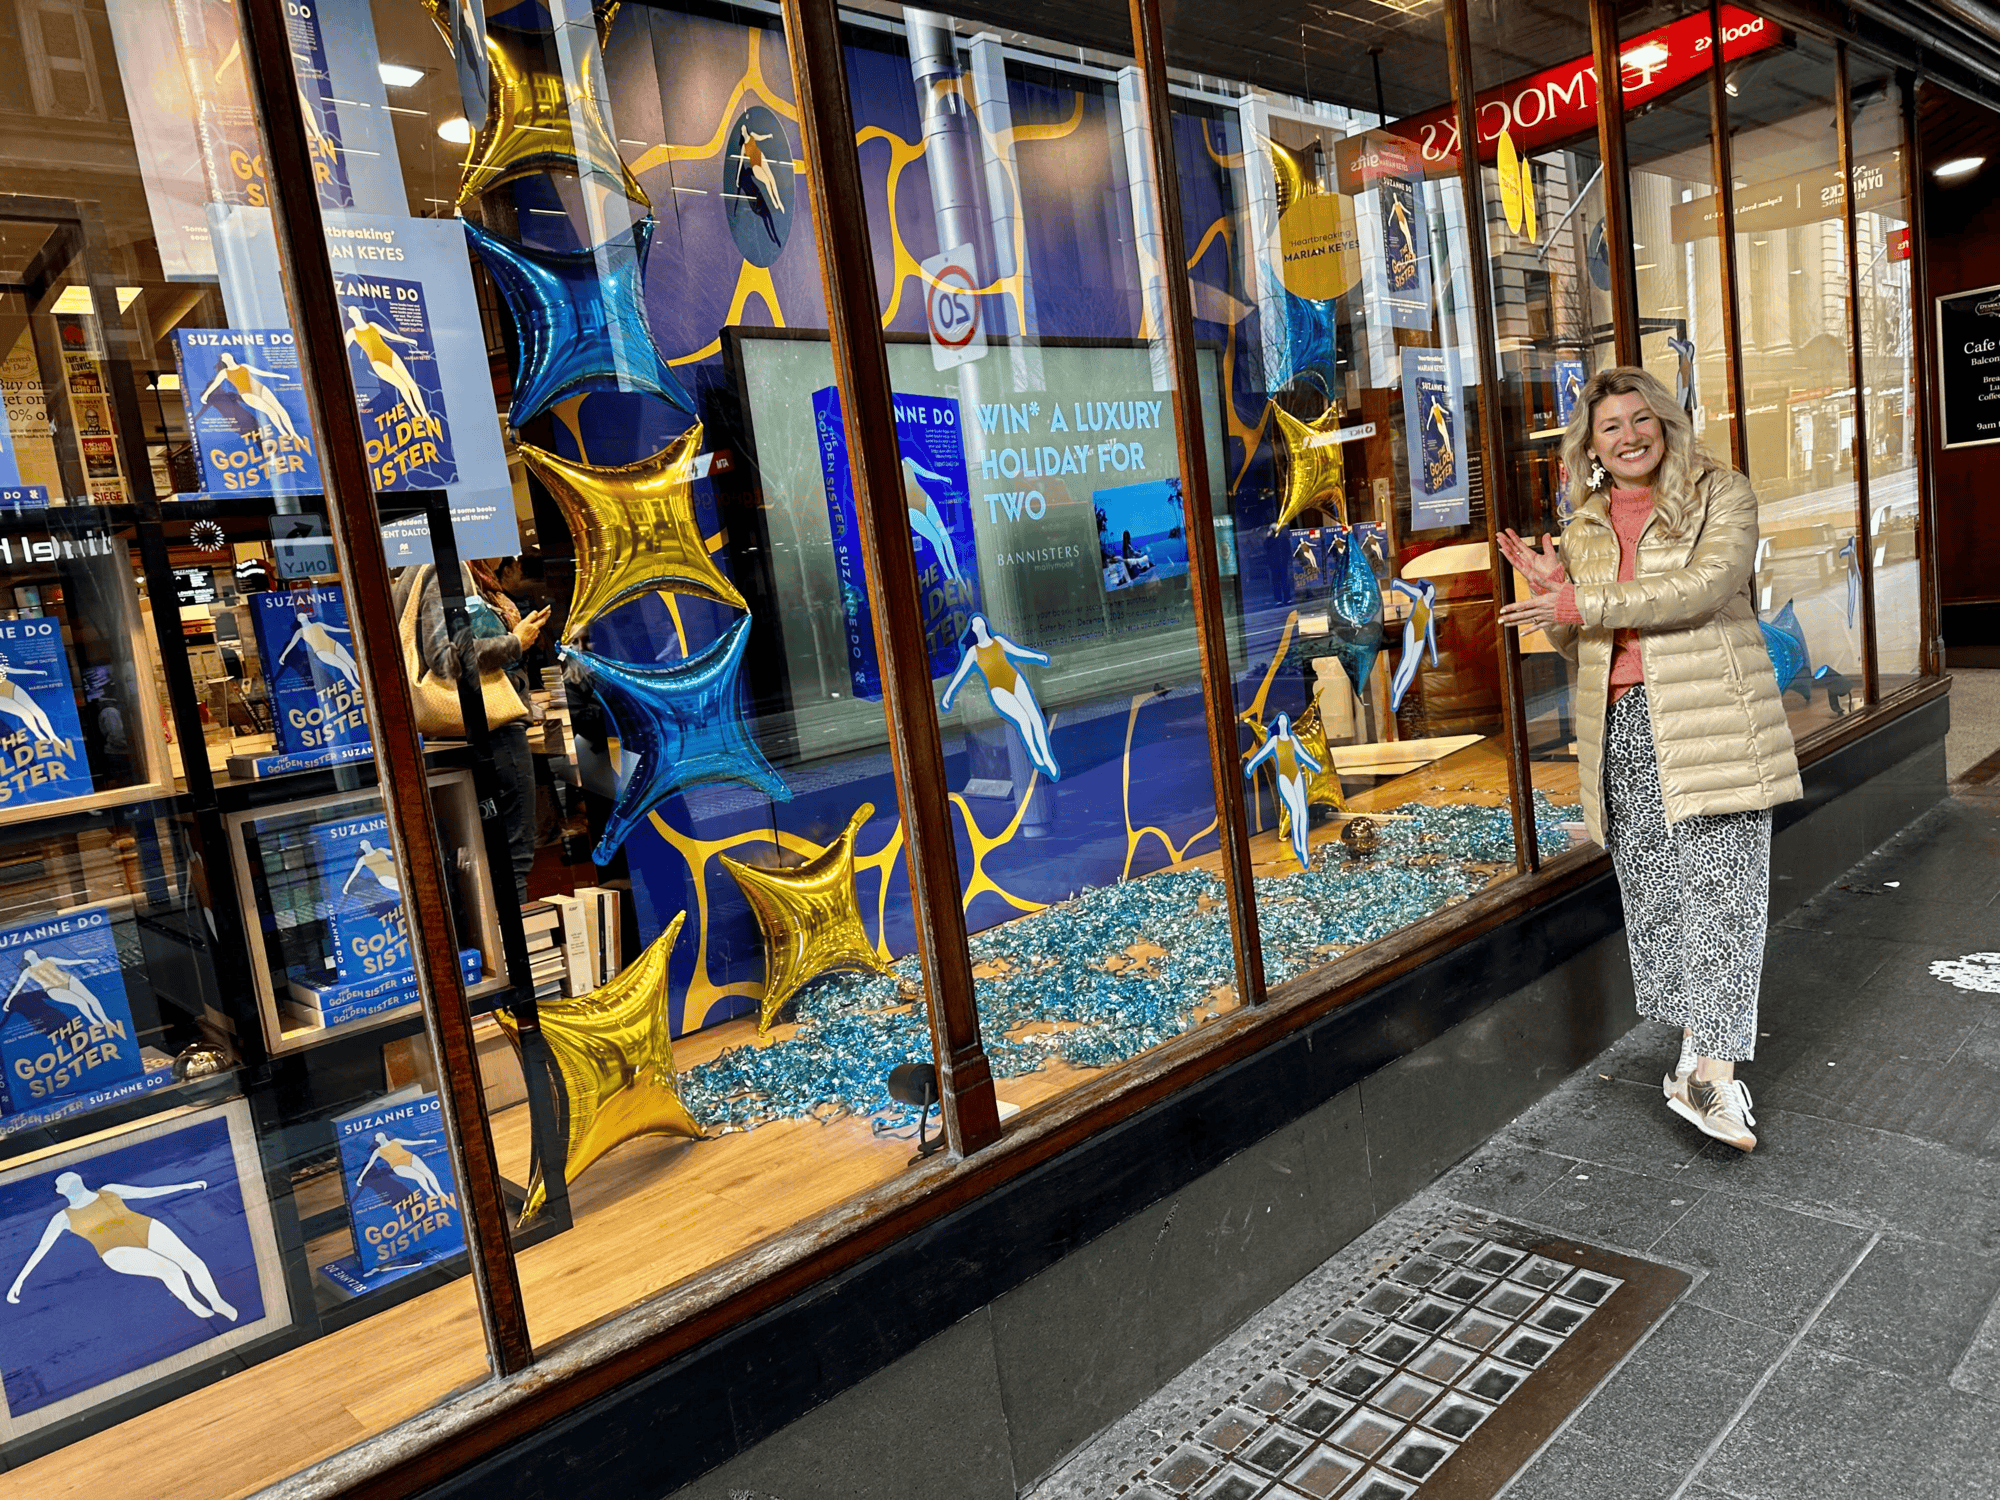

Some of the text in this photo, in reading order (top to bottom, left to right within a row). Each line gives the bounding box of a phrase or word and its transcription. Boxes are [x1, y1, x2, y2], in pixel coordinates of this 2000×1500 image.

[288, 2, 311, 18] DO
[1383, 176, 1405, 190] SUZANNE
[325, 227, 395, 243] tbreaking'
[358, 245, 405, 261] KEYES
[1284, 239, 1360, 262] MARIAN KEYES
[1395, 264, 1415, 288] SISTER
[335, 281, 419, 302] ZANNE DO
[187, 333, 294, 346] SUZANNE DO
[1964, 338, 1996, 355] Cafe
[1971, 355, 2000, 367] Balcon
[1421, 381, 1443, 392] SUZANNE
[1983, 376, 2000, 384] Brea
[26, 396, 46, 405] on
[8, 408, 33, 421] 0%
[374, 402, 407, 431] THE
[933, 408, 955, 426] DO
[1050, 403, 1069, 433] A
[1074, 400, 1162, 432] LUXURY
[1976, 422, 1997, 431] 9am
[241, 424, 274, 445] THE
[366, 416, 444, 464] OLDEN
[817, 410, 836, 473] GOLDEN
[826, 425, 839, 447] THE
[210, 435, 312, 470] GOLDEN
[373, 441, 440, 491] ISTER
[980, 442, 1146, 480] HOLIDAY FOR
[223, 455, 307, 490] SISTER
[1433, 463, 1453, 490] SISTER
[3, 491, 21, 499] DO
[93, 491, 122, 502] SIEGE
[826, 477, 845, 536] SISTER
[983, 490, 1047, 524] TWO
[997, 545, 1080, 567] BANNISTERS
[265, 591, 337, 608] SUZANNE
[839, 545, 858, 627] SUZANNE
[25, 624, 52, 637] DO
[1039, 623, 1056, 633] Sister
[316, 678, 347, 703] THE
[288, 687, 365, 729] GOLDE
[1, 728, 29, 752] HE
[301, 708, 368, 747] SISTE
[0, 738, 77, 777] LDEN
[267, 760, 303, 774] GOLDEN
[304, 753, 337, 768] SISTER
[342, 746, 373, 758] SUZAN
[0, 761, 70, 802] STER
[330, 819, 389, 839] SUZANN
[0, 914, 103, 948] UZANNE DO
[327, 904, 341, 947] SUZANNE
[352, 919, 409, 957] GOL
[363, 939, 411, 974] SIST
[329, 991, 363, 1007] GOLDEN
[365, 979, 398, 998] SISTER
[333, 1007, 367, 1024] GOLDEN
[368, 996, 399, 1015] SISTER
[47, 1015, 83, 1046] THE
[14, 1019, 127, 1080] GOLDEN
[29, 1043, 122, 1098] SISTER
[44, 1101, 84, 1122] SISTER
[89, 1081, 143, 1105] SUZANNE
[146, 1076, 163, 1087] DO
[344, 1100, 440, 1135] SUZANNE DO
[392, 1188, 422, 1215] THE
[364, 1192, 457, 1245] GOLDEN
[376, 1212, 452, 1261] SISTER
